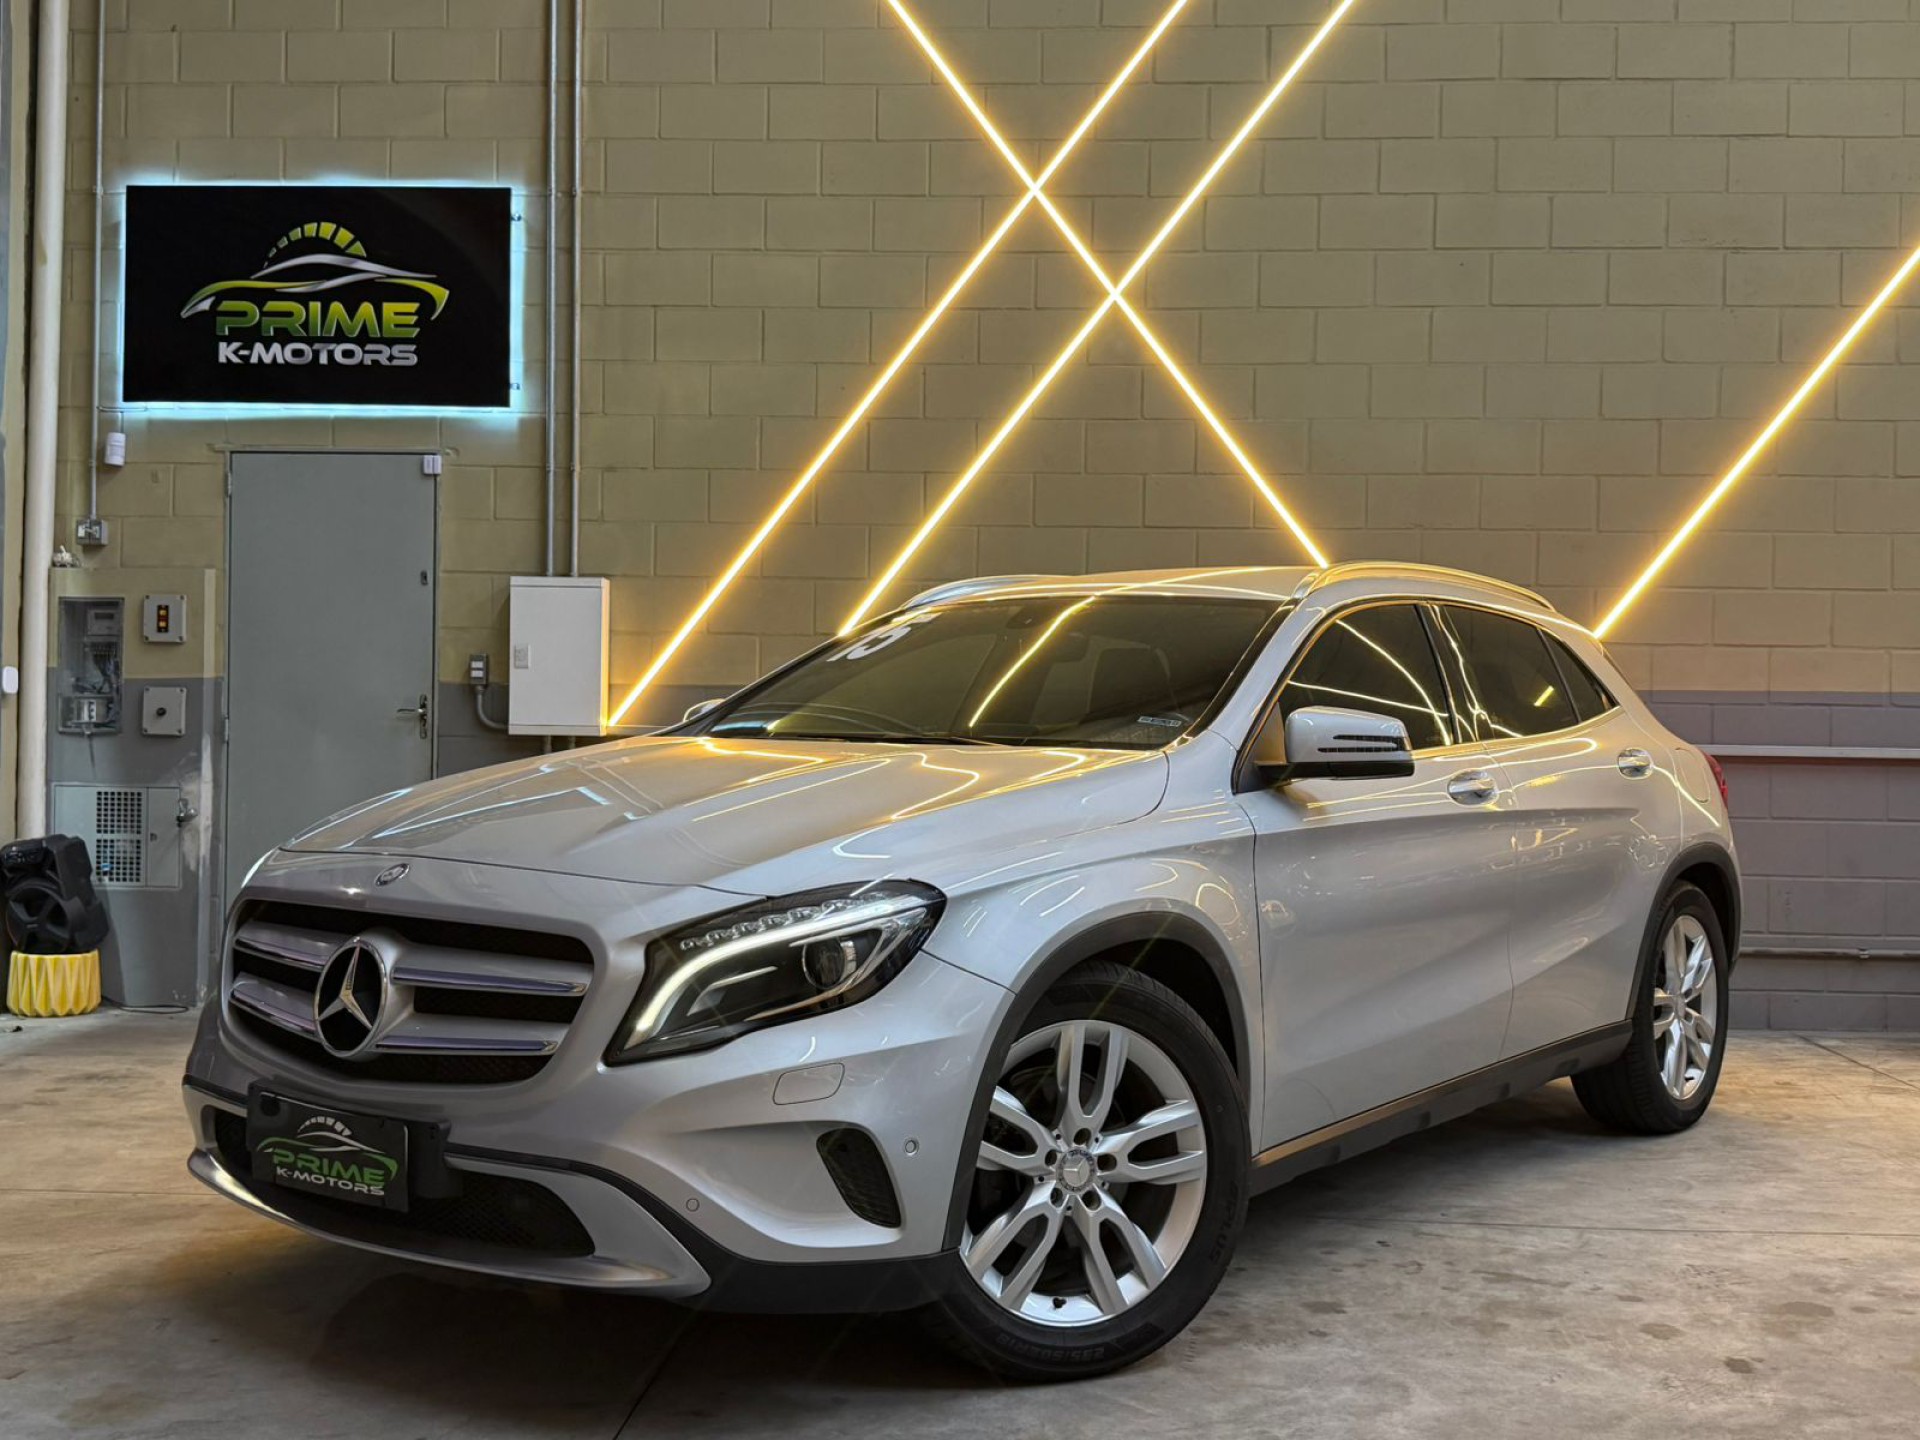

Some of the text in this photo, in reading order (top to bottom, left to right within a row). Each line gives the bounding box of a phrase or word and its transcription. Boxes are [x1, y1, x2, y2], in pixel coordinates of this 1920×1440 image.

[215, 300, 421, 338] PRIME
[218, 341, 419, 367] K-MOTORS
[272, 1149, 385, 1187] PRIME
[276, 1165, 385, 1196] K-MOTORS
